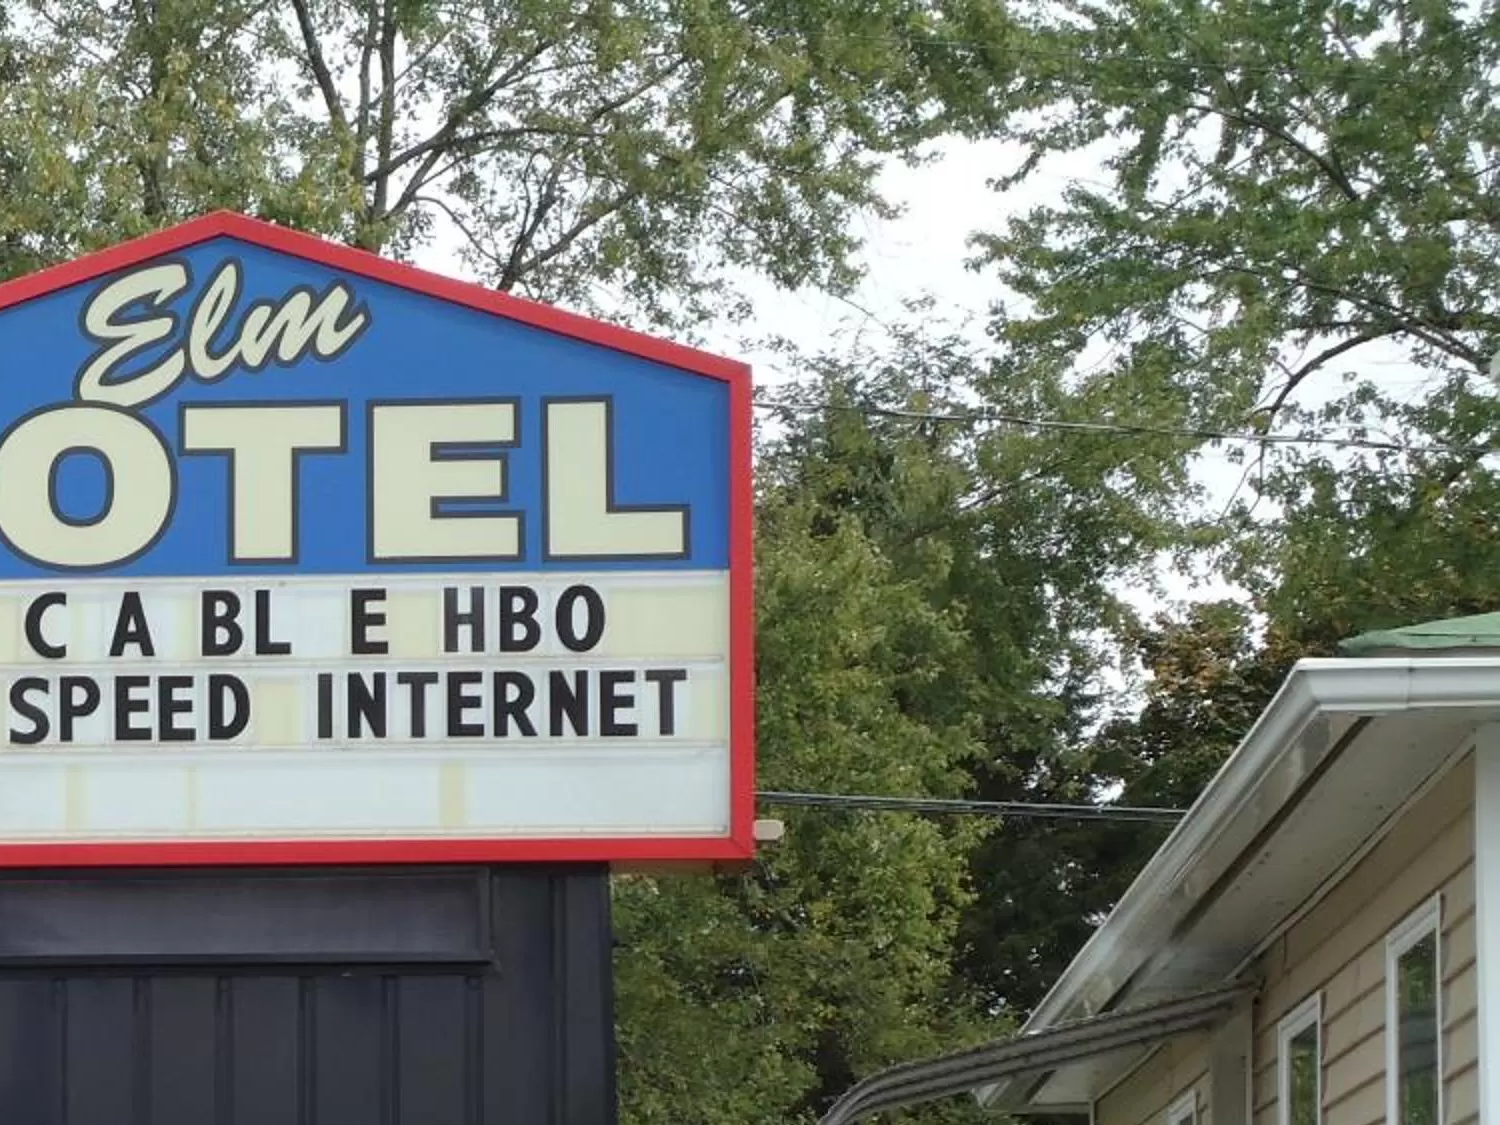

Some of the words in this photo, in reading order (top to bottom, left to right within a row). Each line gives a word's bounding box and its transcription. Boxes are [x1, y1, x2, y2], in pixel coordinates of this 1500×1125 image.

[75, 256, 368, 406] Elm
[25, 588, 390, 659] CABLE
[444, 584, 606, 654] HBO
[8, 674, 251, 745] SPEED
[317, 669, 687, 738] INTERNET
